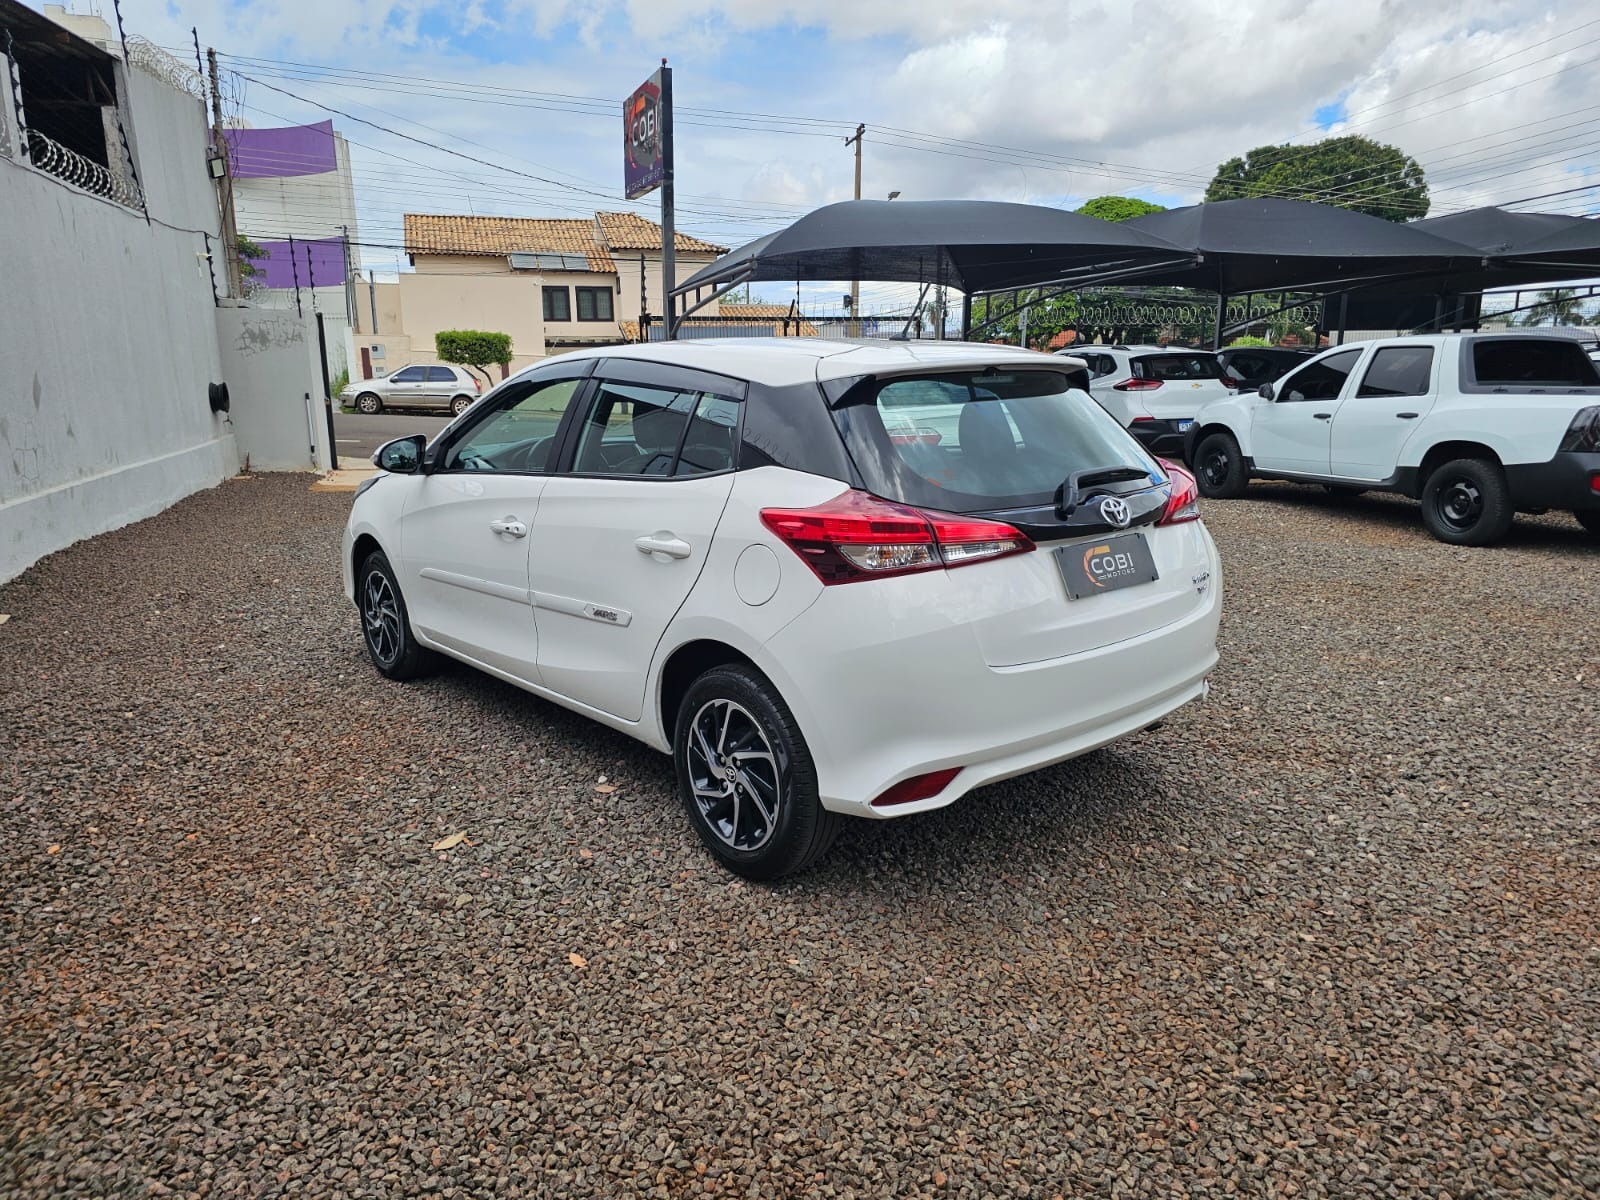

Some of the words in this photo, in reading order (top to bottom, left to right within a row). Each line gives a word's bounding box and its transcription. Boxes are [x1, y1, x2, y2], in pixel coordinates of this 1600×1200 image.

[632, 104, 659, 147] COBI
[1090, 552, 1134, 574] COBI
[1106, 567, 1136, 579] MOTORS
